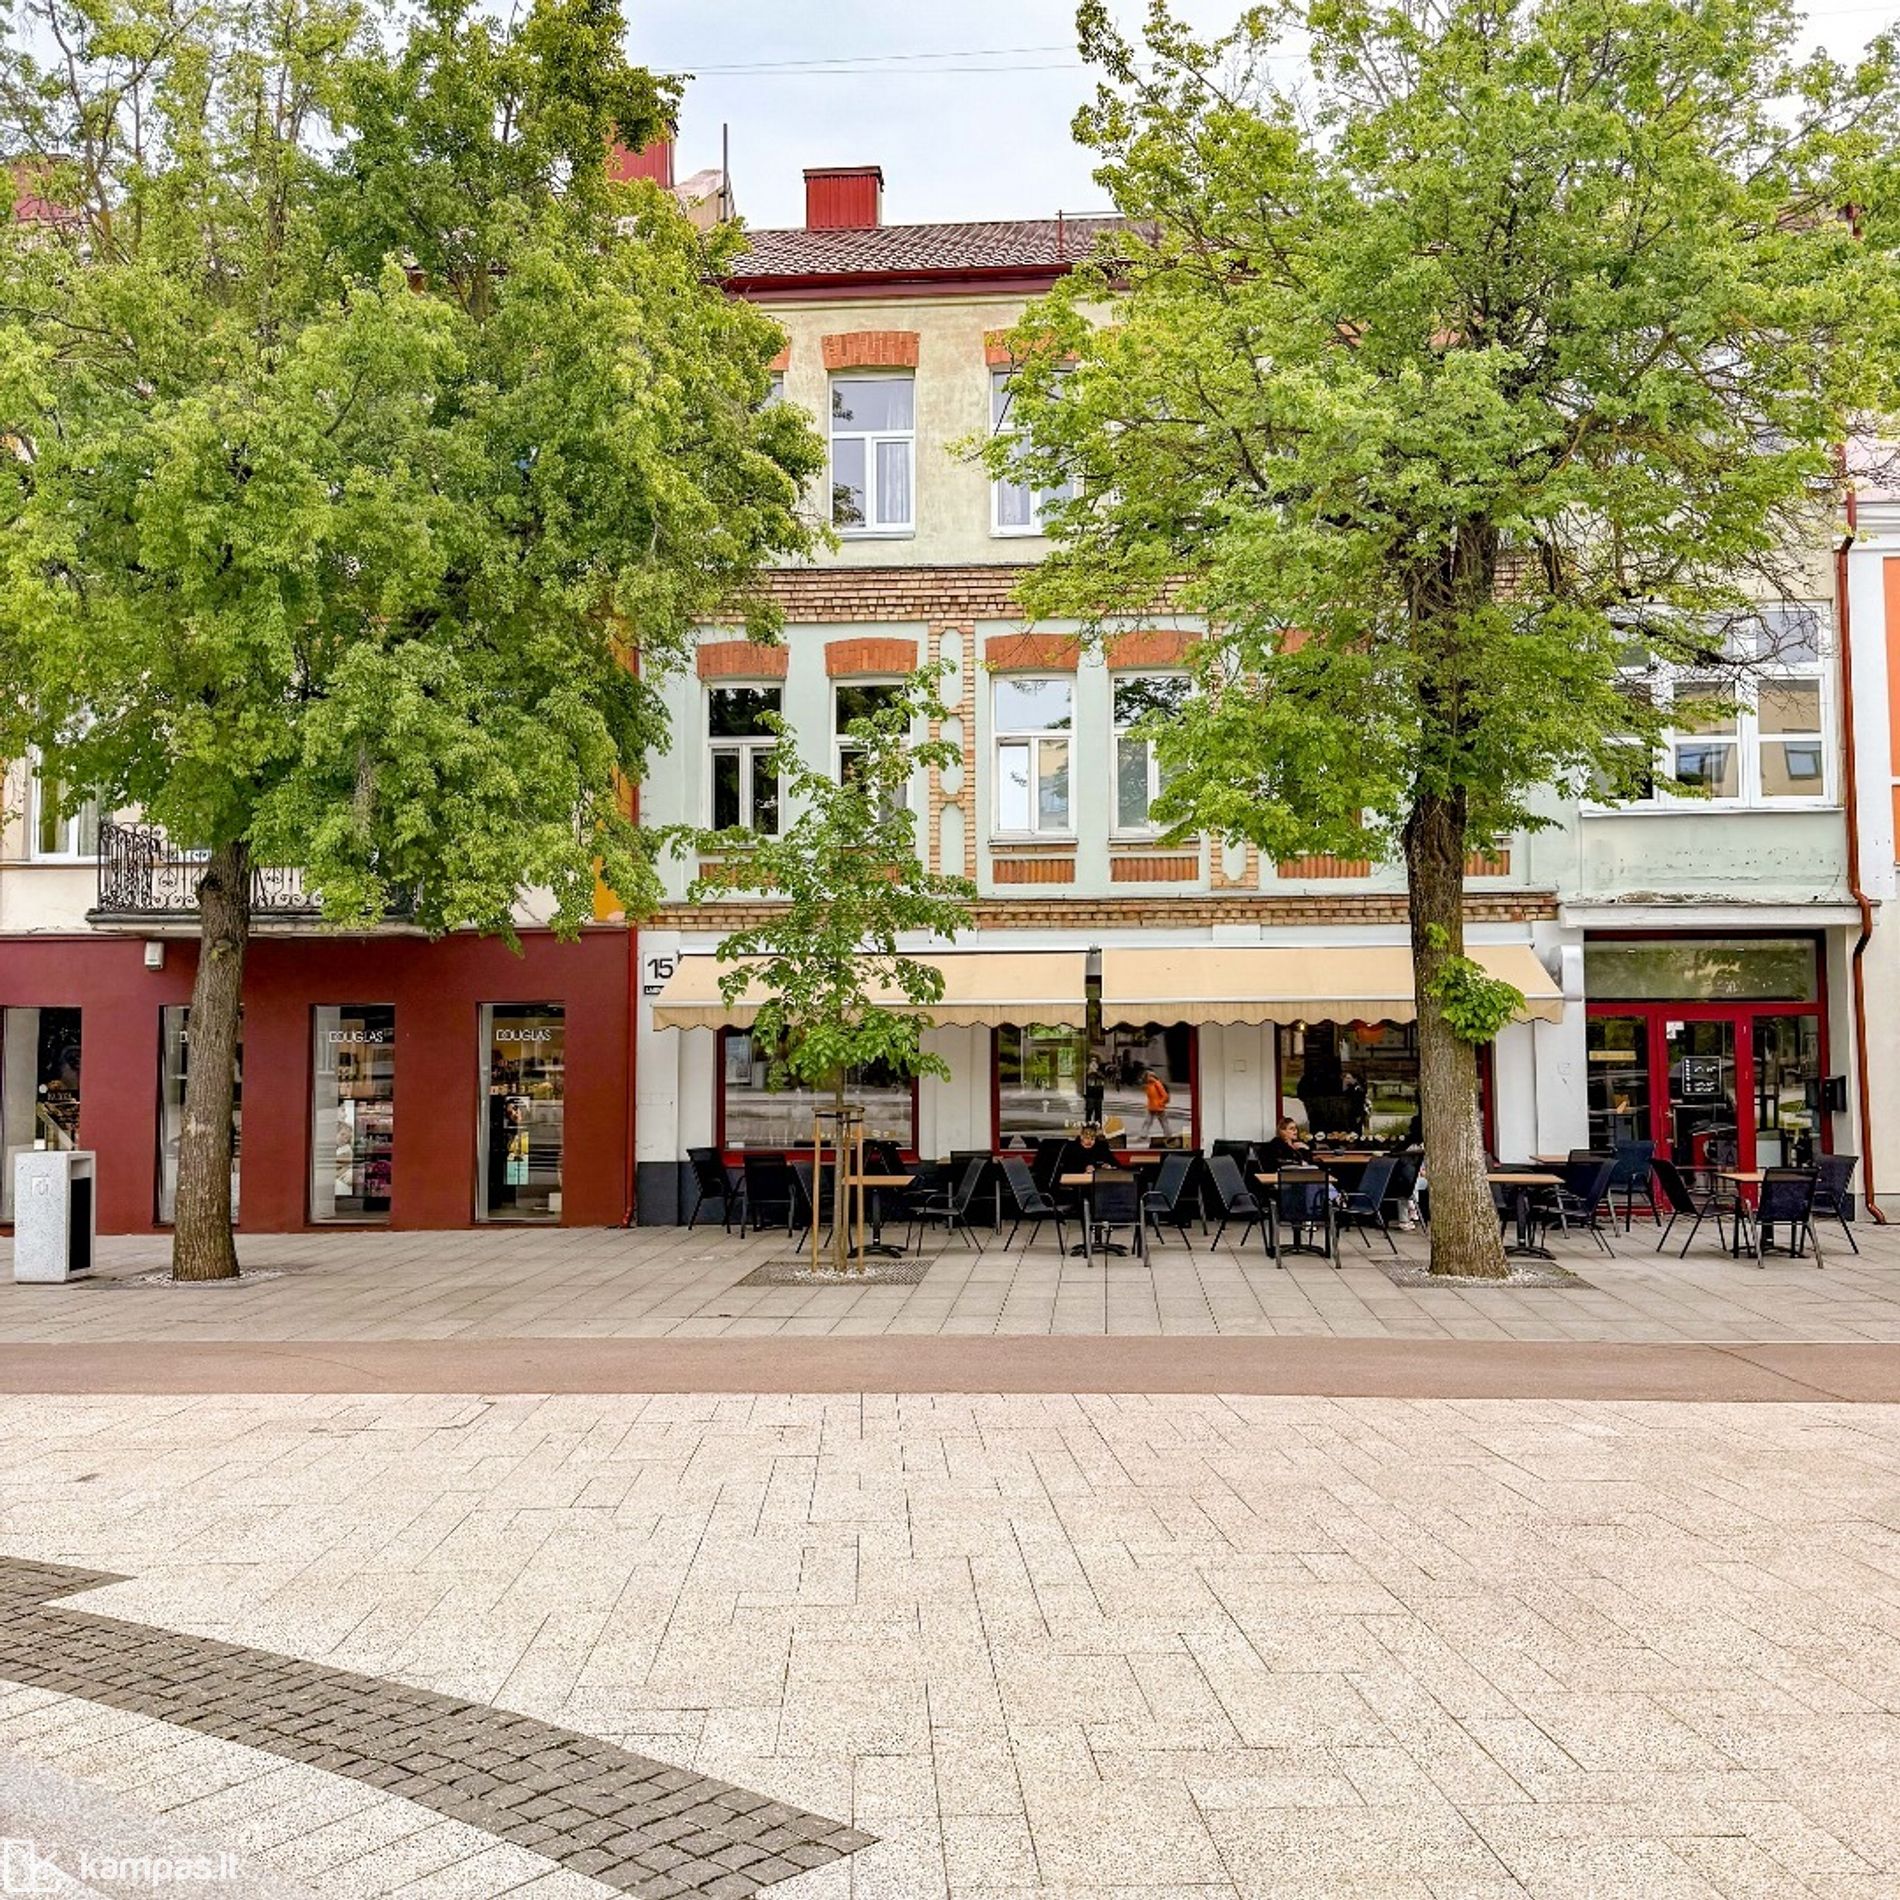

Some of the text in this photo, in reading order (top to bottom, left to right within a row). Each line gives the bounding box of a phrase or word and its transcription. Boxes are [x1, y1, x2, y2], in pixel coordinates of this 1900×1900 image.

[647, 958, 673, 979] 15
[328, 1030, 384, 1043] DOUGLAS
[496, 1028, 552, 1041] DOUGLAS
